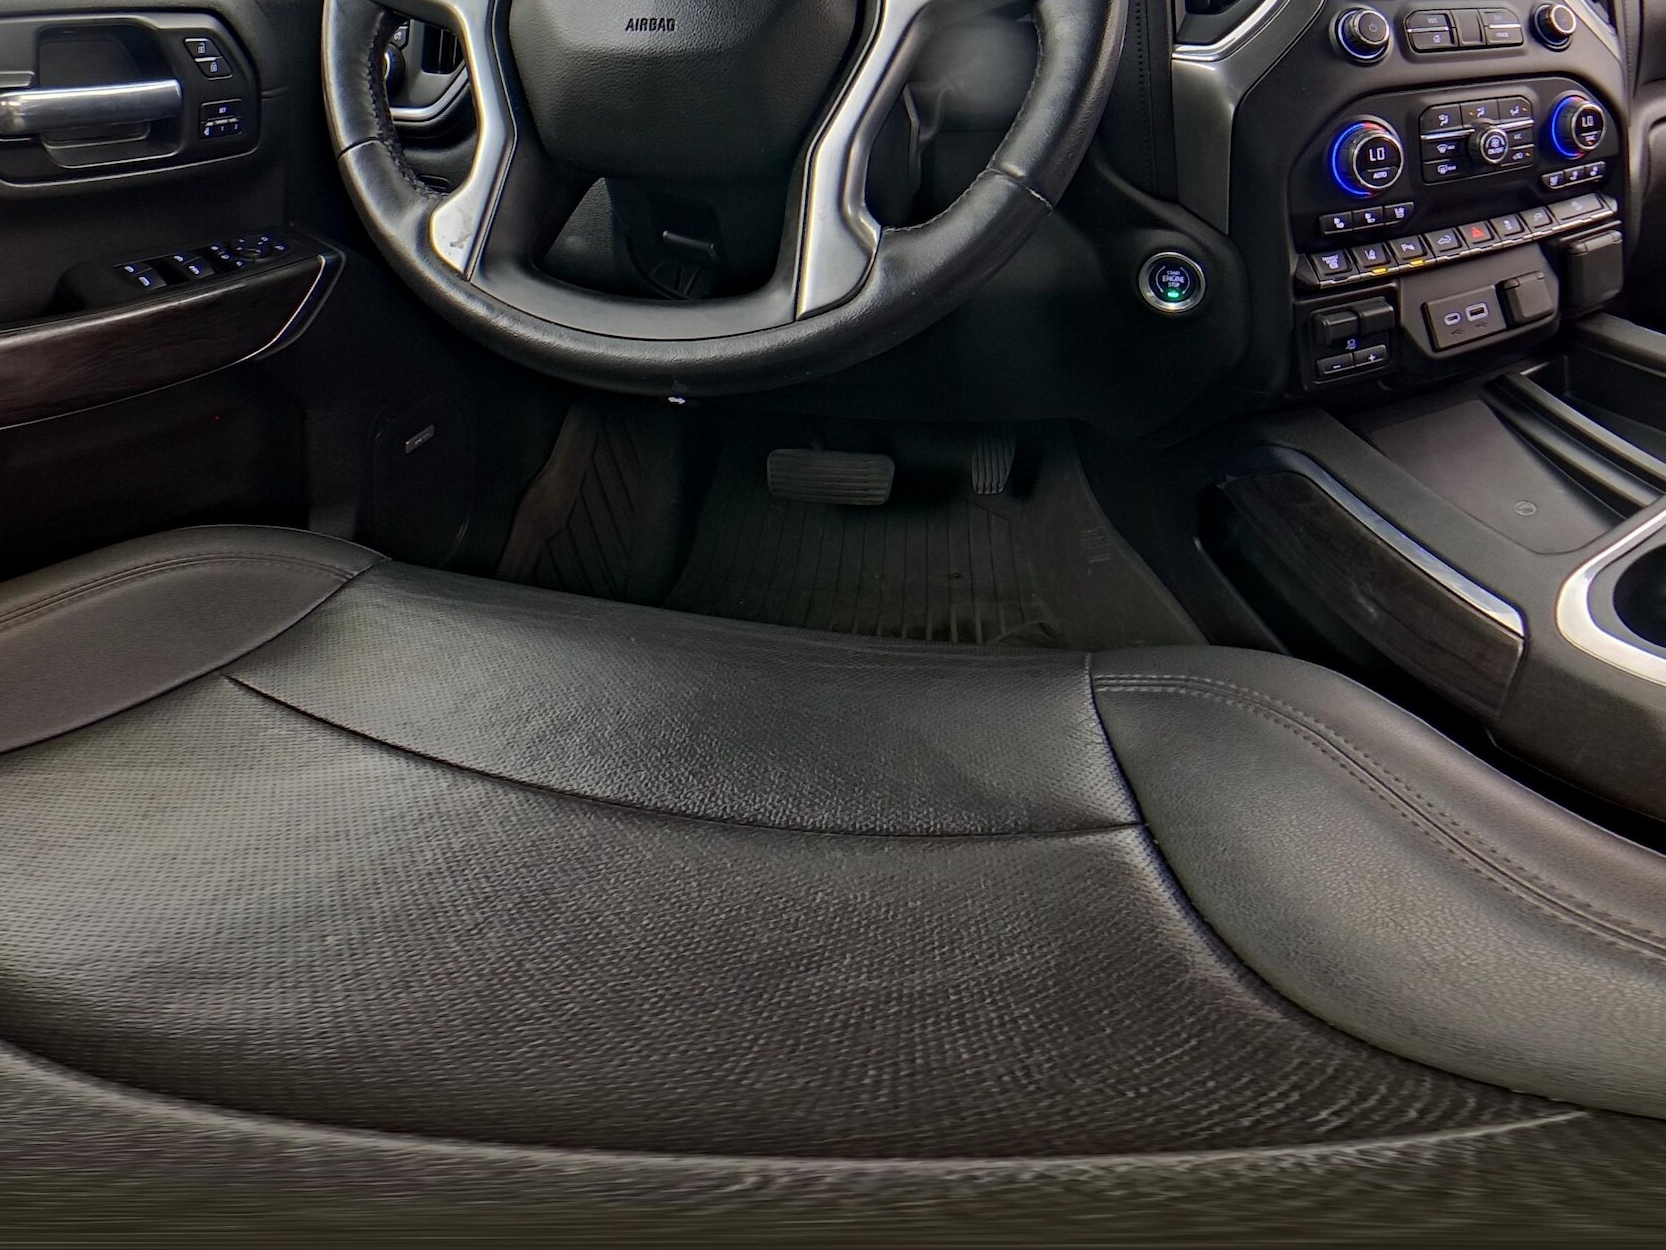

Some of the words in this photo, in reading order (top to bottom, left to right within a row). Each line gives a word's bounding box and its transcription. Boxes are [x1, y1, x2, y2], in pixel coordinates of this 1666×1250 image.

[624, 17, 676, 32] AIRBAG
[1581, 115, 1594, 128] LO
[1368, 146, 1386, 162] LO
[1162, 275, 1185, 284] ENGINE
